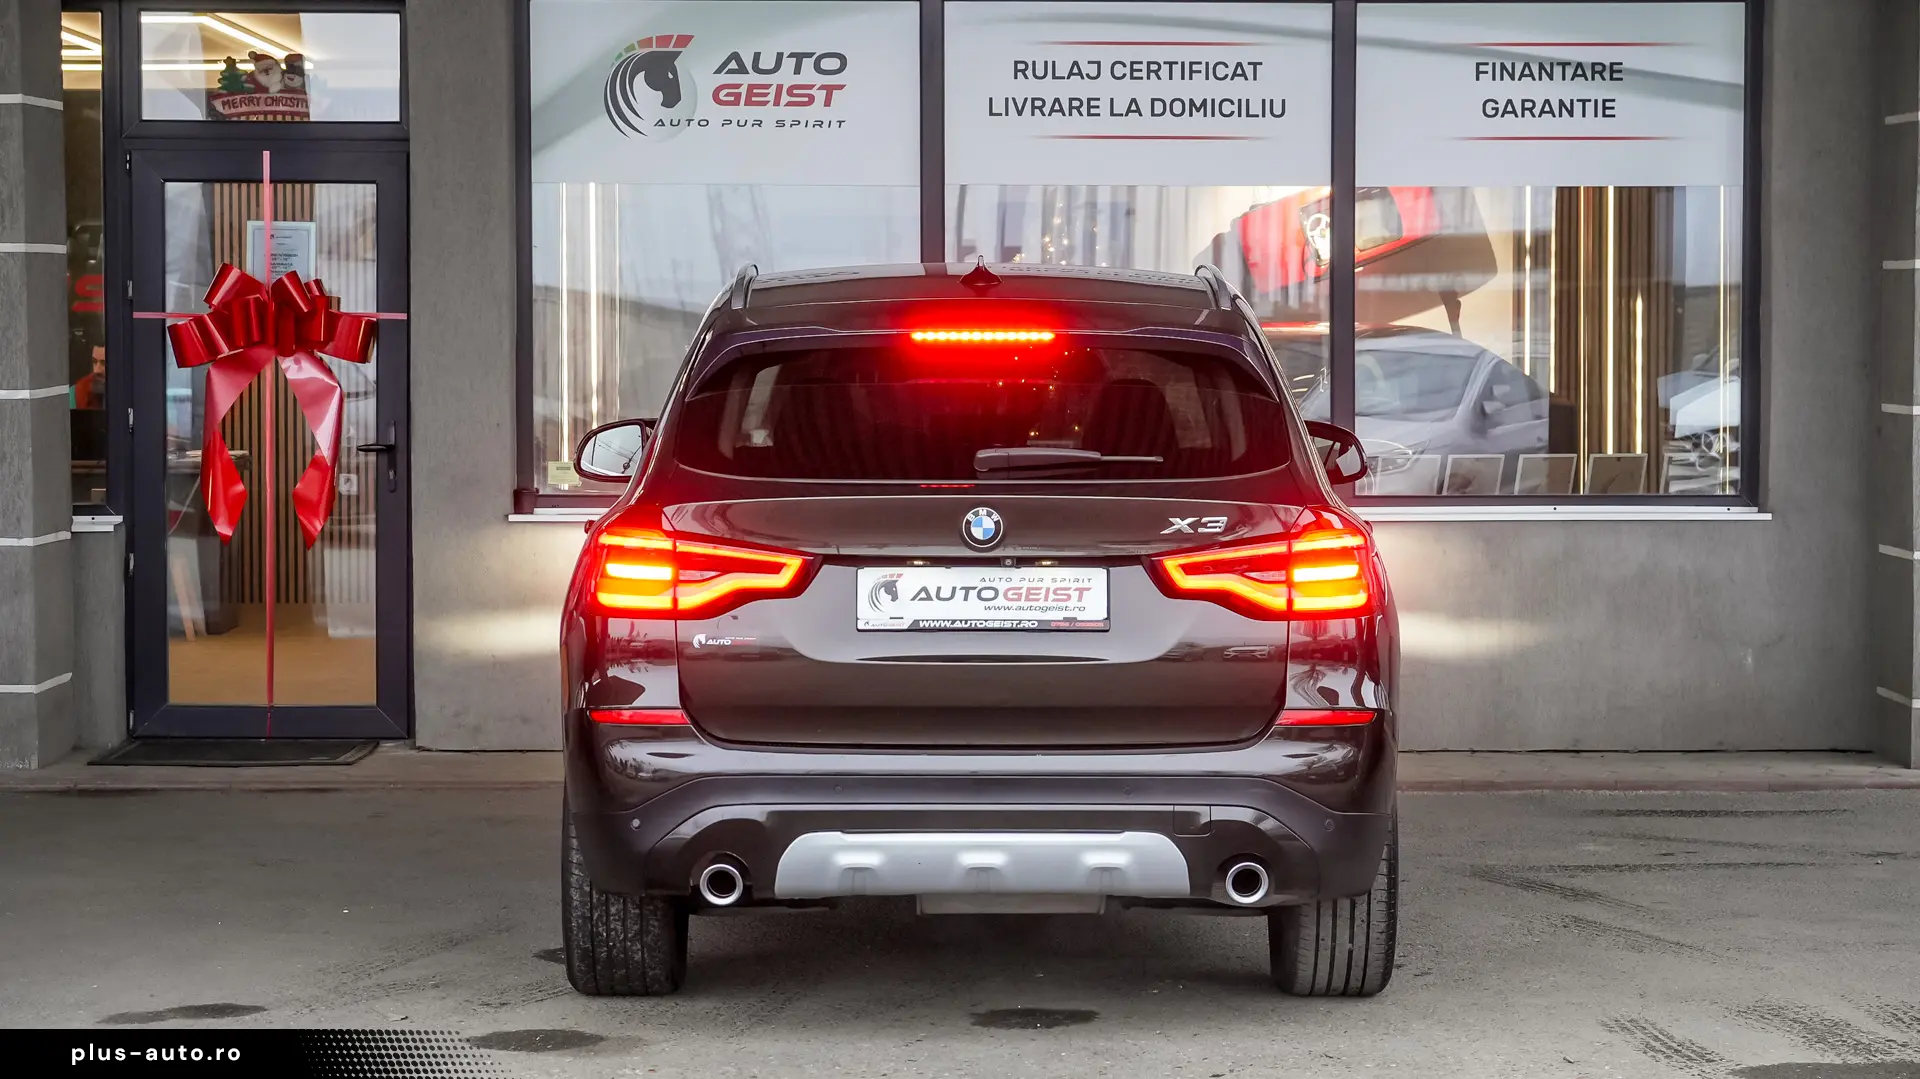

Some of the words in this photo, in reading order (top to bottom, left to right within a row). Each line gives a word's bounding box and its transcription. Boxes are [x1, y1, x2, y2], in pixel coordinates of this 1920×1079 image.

[712, 51, 848, 76] AUTO
[1013, 60, 1102, 82] RULAJ
[1110, 60, 1263, 82] CERTIFICAT
[1475, 61, 1624, 82] FINANTARE
[221, 96, 262, 111] MERRY
[711, 83, 847, 108] GEIST
[988, 97, 1101, 118] LIVRARE
[1109, 97, 1144, 118] LA
[1150, 97, 1287, 119] DOMICILIU
[1482, 98, 1617, 119] GARANTIE
[653, 118, 710, 129] AUTO
[721, 118, 763, 129] PUR
[774, 118, 847, 129] SPIRIT
[967, 508, 1000, 522] BMW
[1159, 516, 1229, 535] X3
[984, 604, 1086, 614] www.autogeist.ro
[918, 620, 1039, 629] WWW.AUTOGEIST.RO
